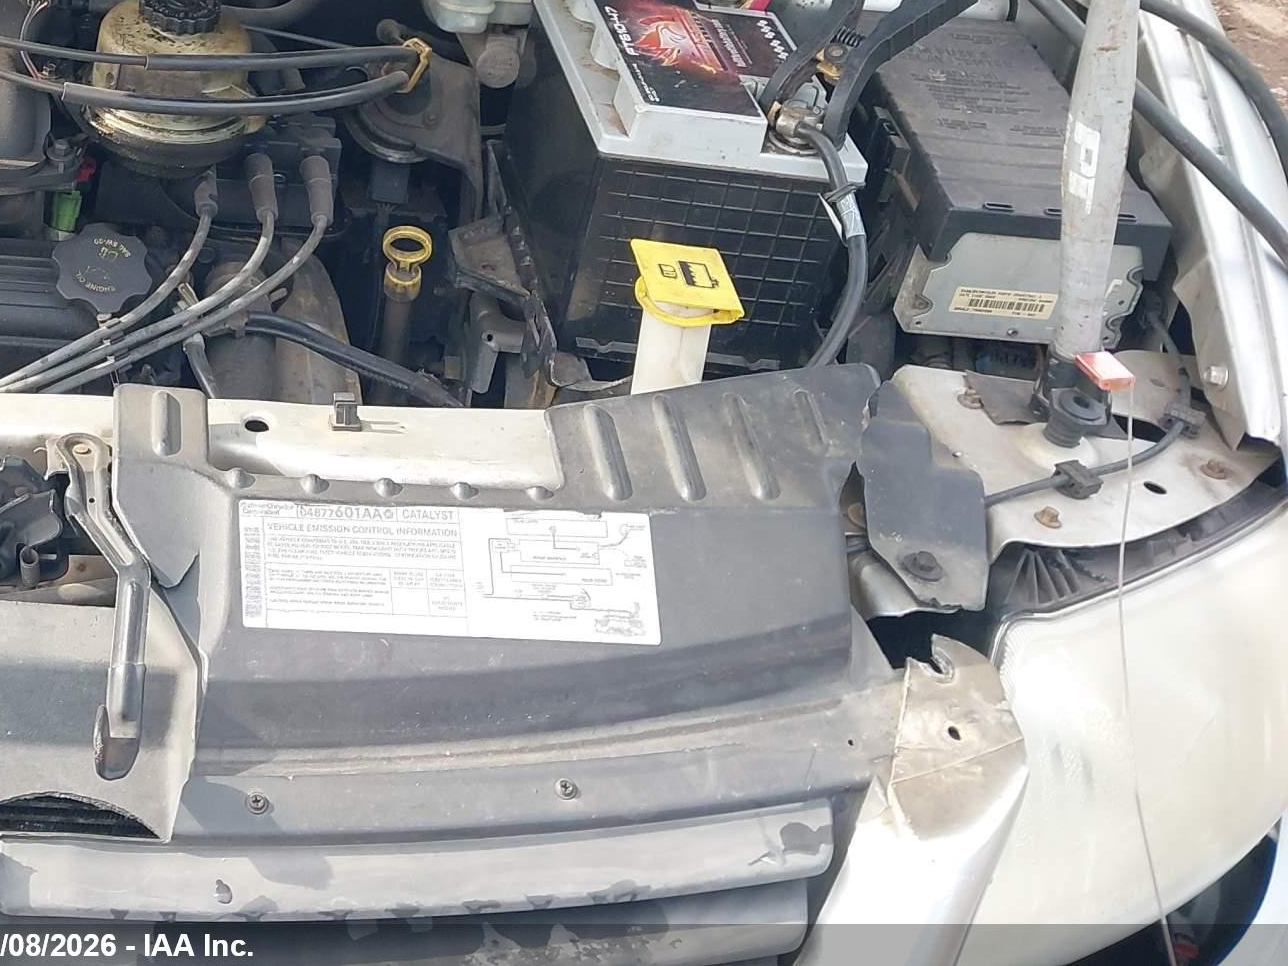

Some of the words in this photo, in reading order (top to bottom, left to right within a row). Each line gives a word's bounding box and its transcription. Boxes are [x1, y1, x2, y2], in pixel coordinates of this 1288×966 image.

[402, 509, 454, 521] CATALYST
[267, 522, 304, 532] VEHICLE
[307, 523, 350, 533] EMISSION
[352, 525, 395, 535] CONTROL
[397, 527, 458, 537] INFORMATION
